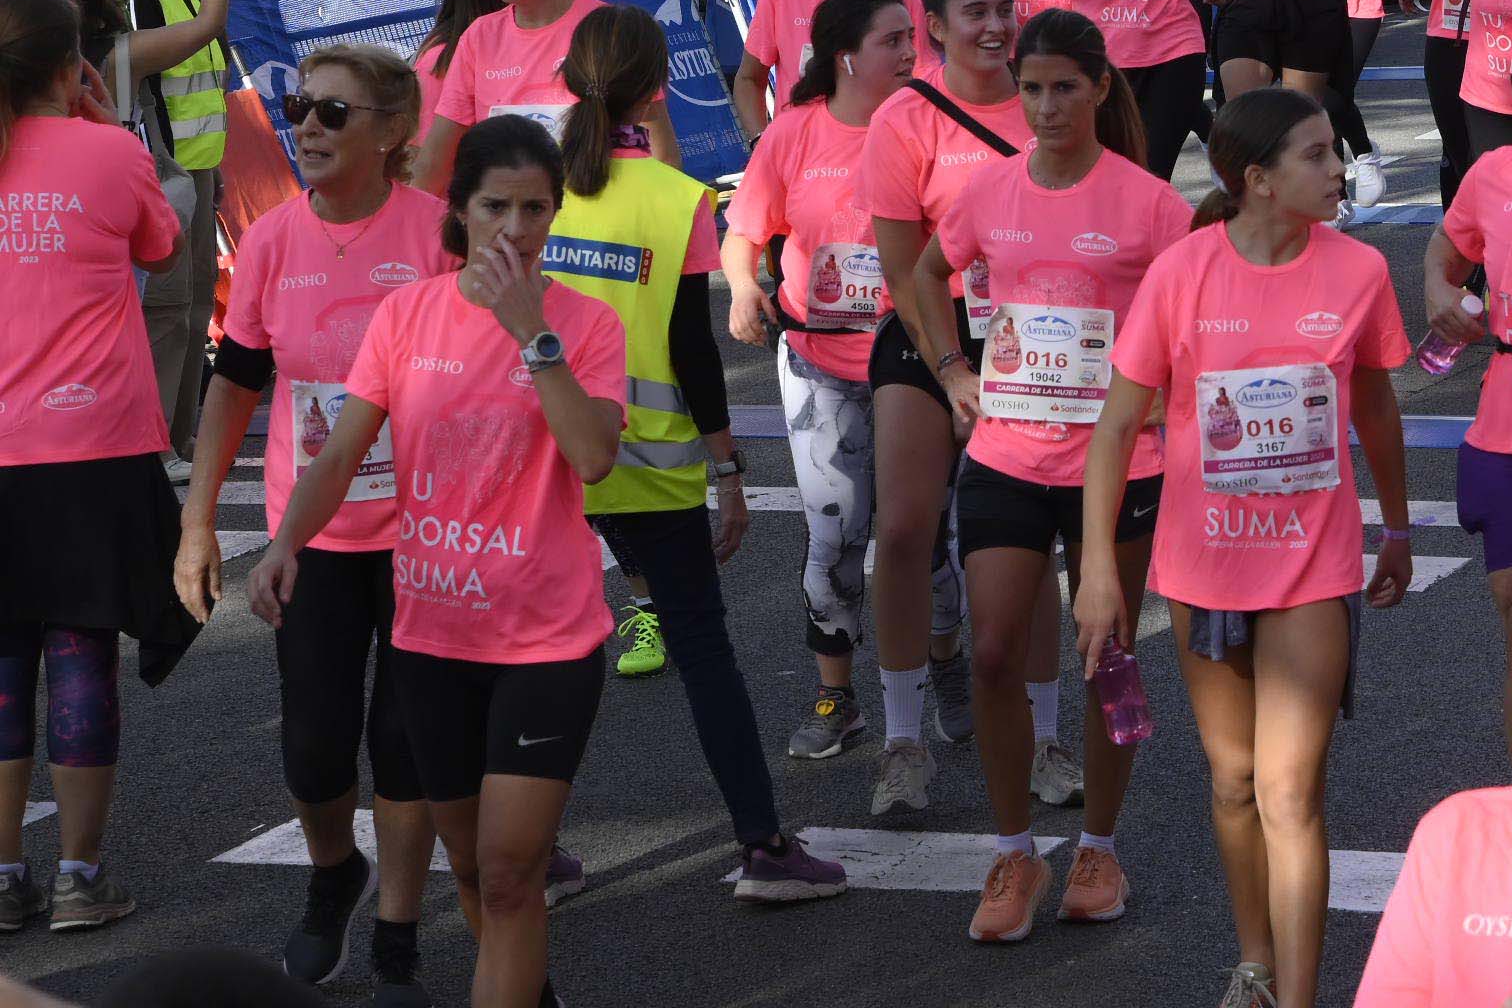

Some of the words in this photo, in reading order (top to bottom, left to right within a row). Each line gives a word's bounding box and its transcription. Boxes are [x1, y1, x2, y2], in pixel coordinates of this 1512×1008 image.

[1100, 6, 1150, 24] SUMA
[1479, 11, 1504, 30] TU
[486, 65, 522, 81] OYSHO
[941, 150, 989, 167] OYSHO
[804, 166, 850, 181] OYSHO
[32, 212, 63, 232] LA
[989, 228, 1033, 244] OYSHO
[19, 255, 39, 264] 2023
[538, 244, 637, 274] LUNTARIS
[279, 271, 327, 291] OYSHO
[372, 269, 418, 283] ASTURIANA
[845, 283, 882, 301] 016
[850, 302, 876, 312] 4503
[1025, 324, 1072, 338] ASTURIANA
[411, 355, 465, 375] OYSHO
[1025, 350, 1069, 369] 016
[1029, 372, 1063, 384] 19042
[996, 384, 1030, 394] CARRERA
[1053, 388, 1079, 397] MUJER
[1241, 390, 1294, 404] ASTURIANA
[46, 393, 95, 405] ASTURIANA
[992, 399, 1030, 411] OYSHO
[1246, 416, 1294, 438] 016
[1256, 441, 1286, 454] 3167
[1218, 460, 1256, 471] CARRERA
[1257, 459, 1269, 468] DE
[1270, 458, 1281, 467] LA
[1283, 455, 1309, 466] MUJER
[1216, 476, 1258, 489] OYSHO
[1204, 506, 1307, 539] SUMA
[402, 510, 528, 557] DORSAL
[397, 554, 488, 599] SUMA
